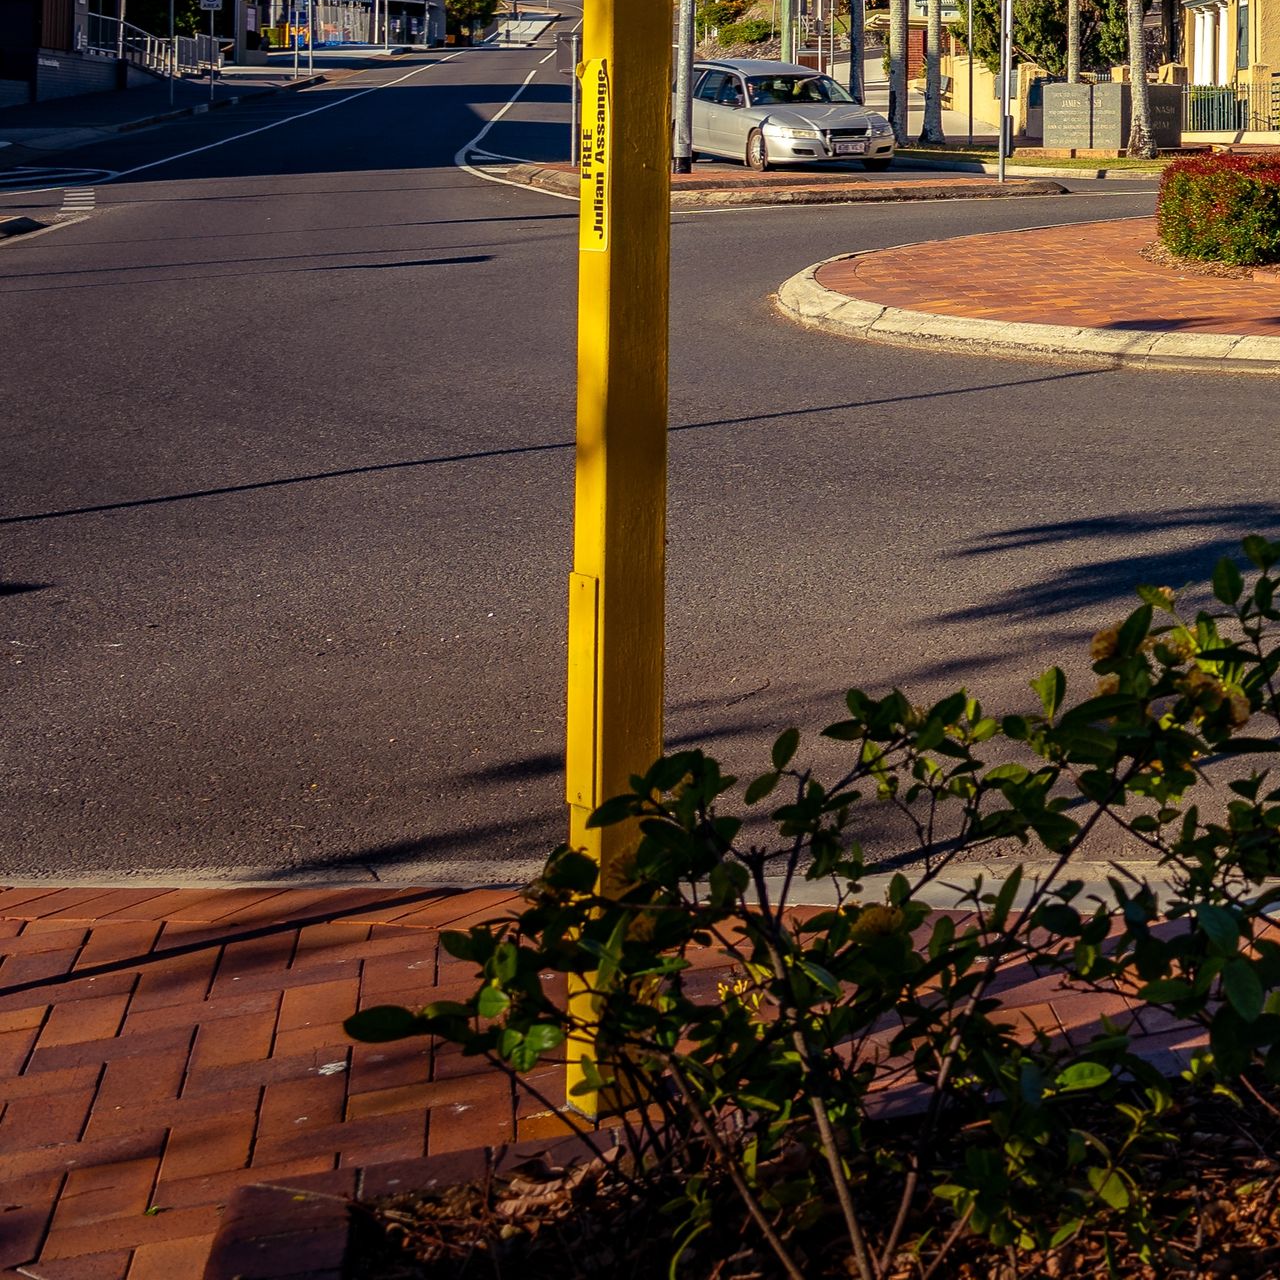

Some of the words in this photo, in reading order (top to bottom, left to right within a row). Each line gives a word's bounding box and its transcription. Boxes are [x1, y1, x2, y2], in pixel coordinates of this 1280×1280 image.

[594, 68, 607, 164] Assange
[582, 128, 593, 179] FREE
[593, 171, 605, 240] Julian
